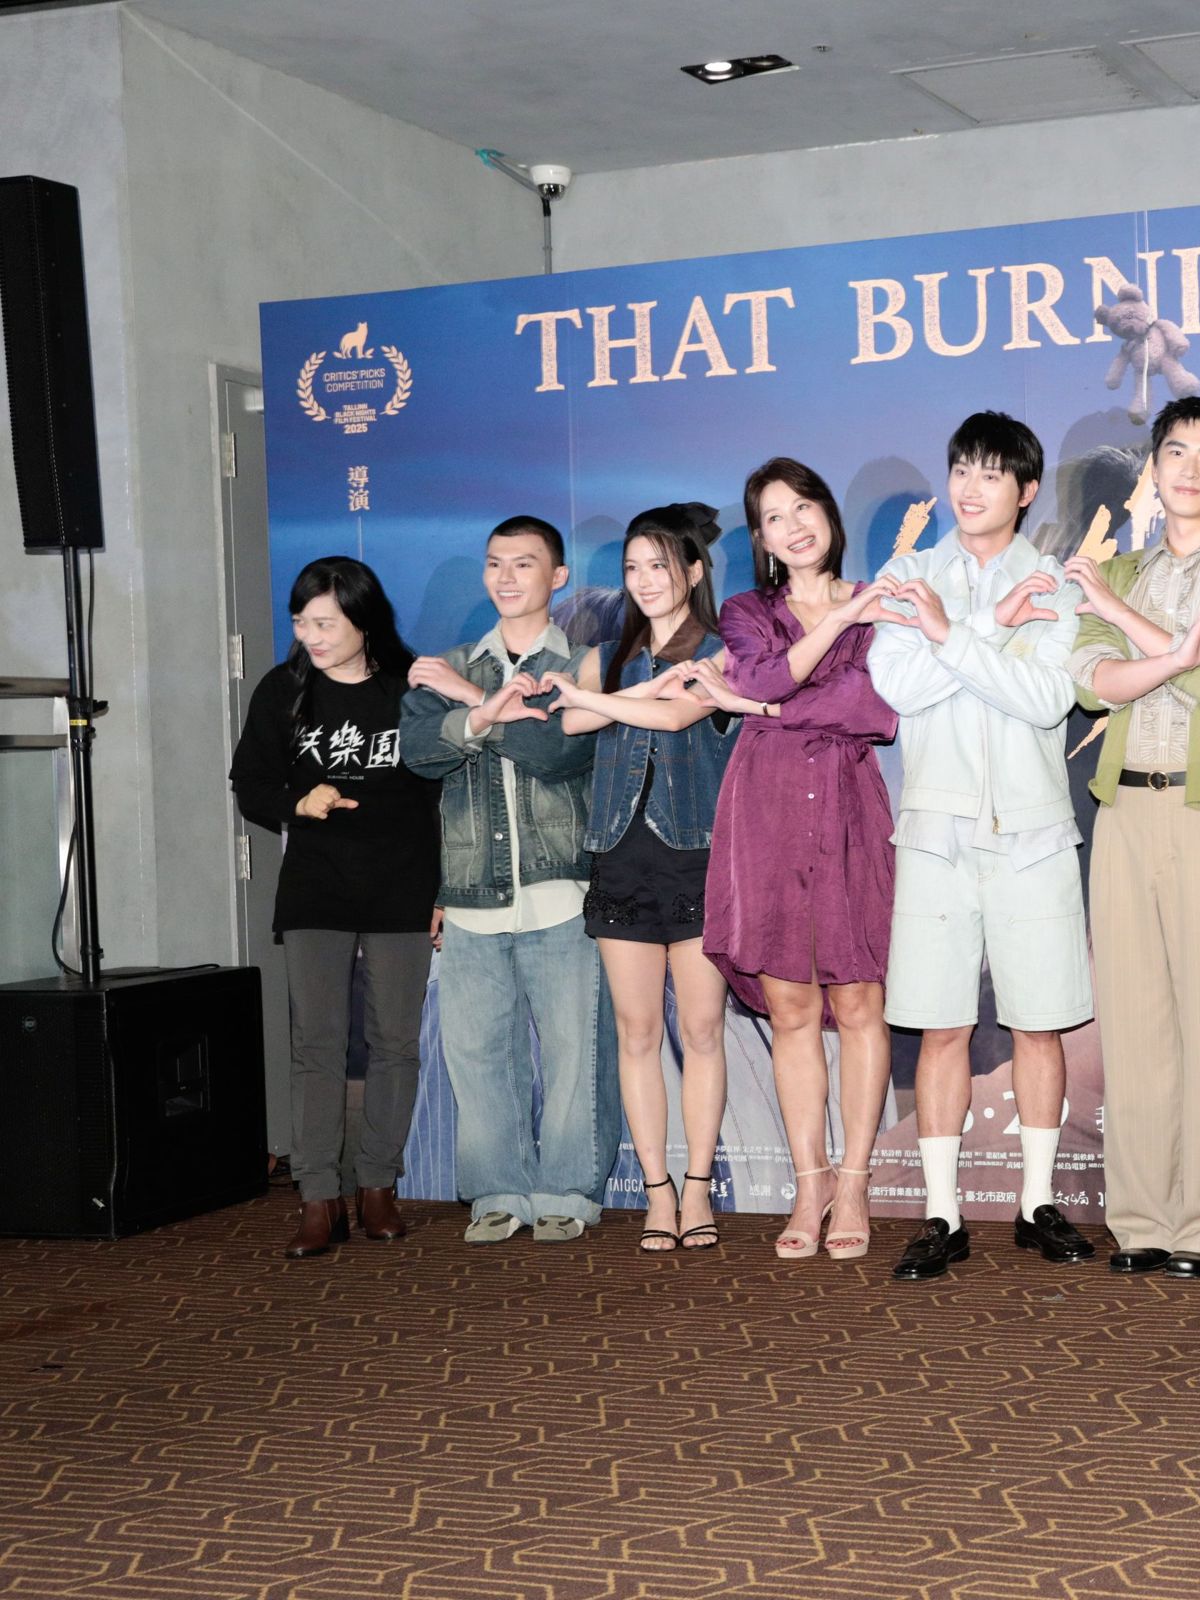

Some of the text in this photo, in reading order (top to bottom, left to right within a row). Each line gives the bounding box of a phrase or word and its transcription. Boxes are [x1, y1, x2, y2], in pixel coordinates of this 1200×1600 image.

[515, 287, 795, 392] THAT
[360, 368, 386, 380] PICKS
[326, 379, 384, 393] COMPETITION
[344, 423, 368, 434] 2025
[348, 466, 370, 511] 導演
[297, 720, 400, 769] 失樂園
[964, 1190, 1017, 1204] 臺北市政府
